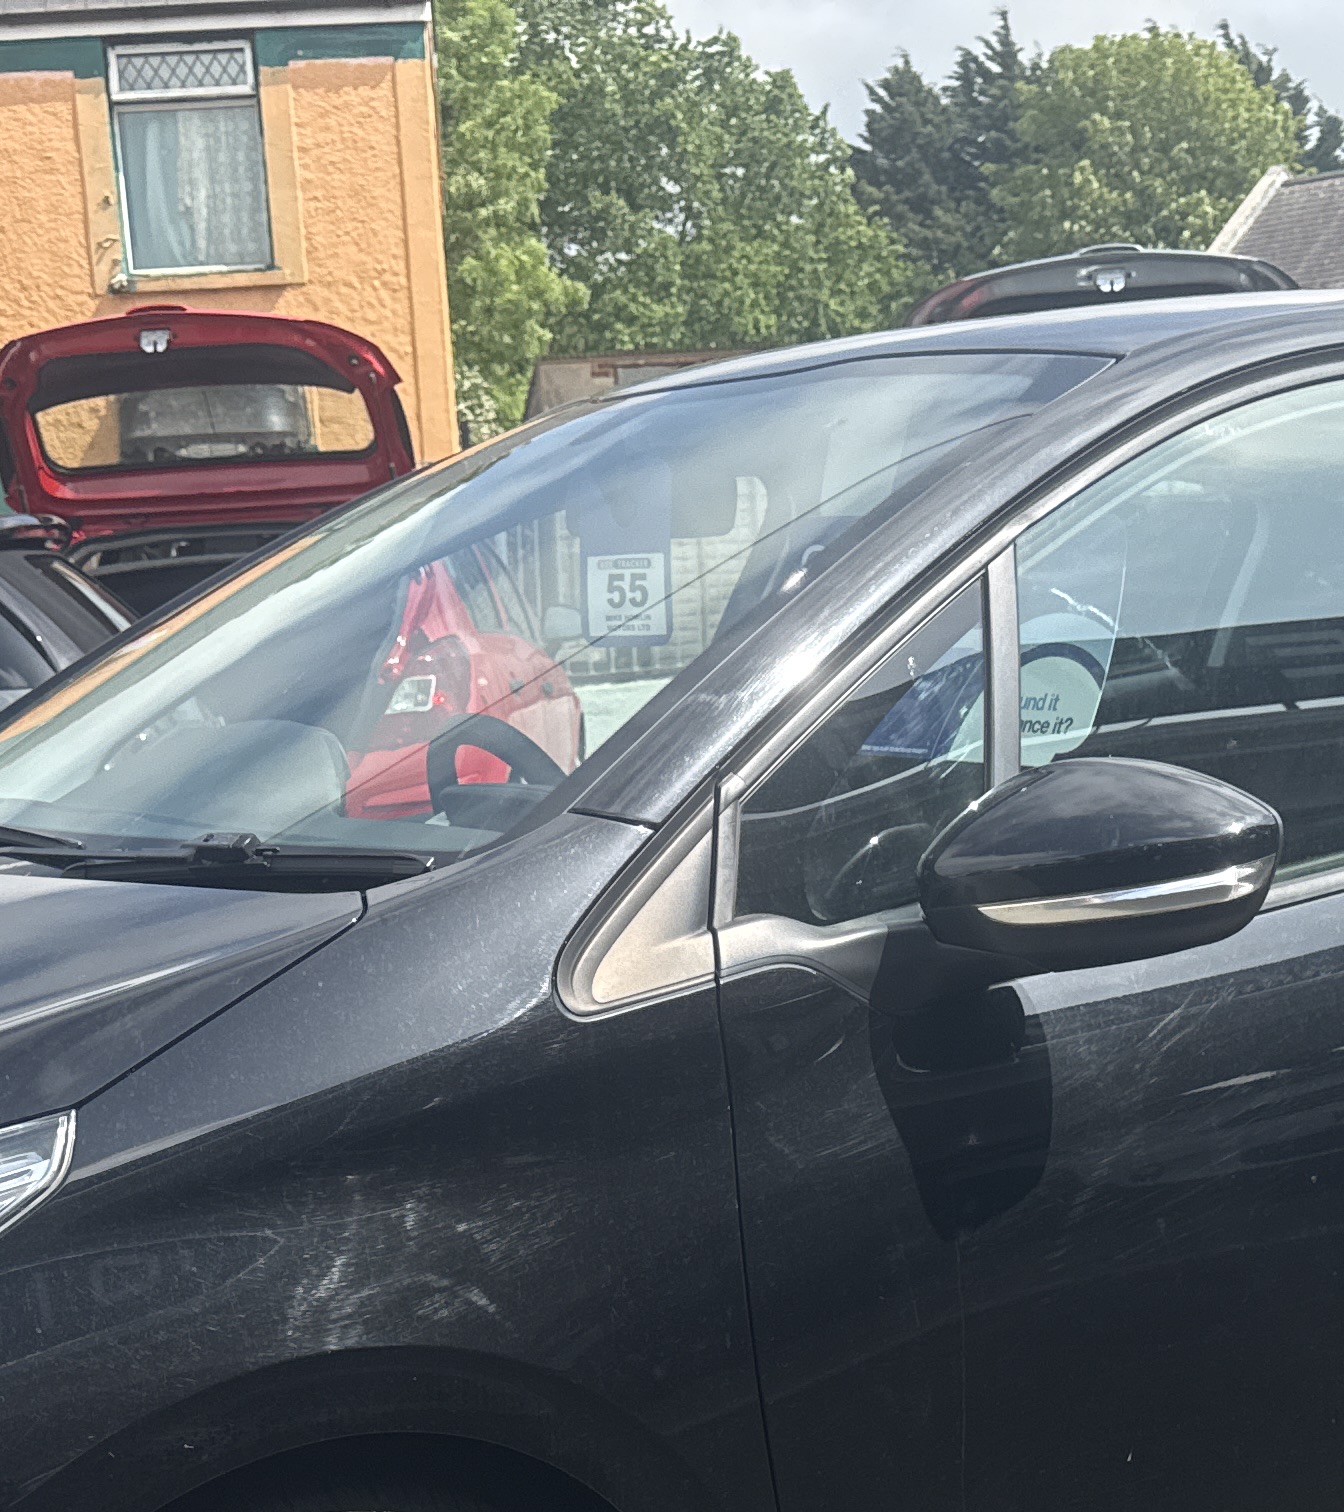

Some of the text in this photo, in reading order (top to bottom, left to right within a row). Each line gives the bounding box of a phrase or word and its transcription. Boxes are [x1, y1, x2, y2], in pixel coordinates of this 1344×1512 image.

[607, 572, 649, 609] 55
[1021, 693, 1060, 711] und it
[1021, 717, 1074, 735] nce it?
